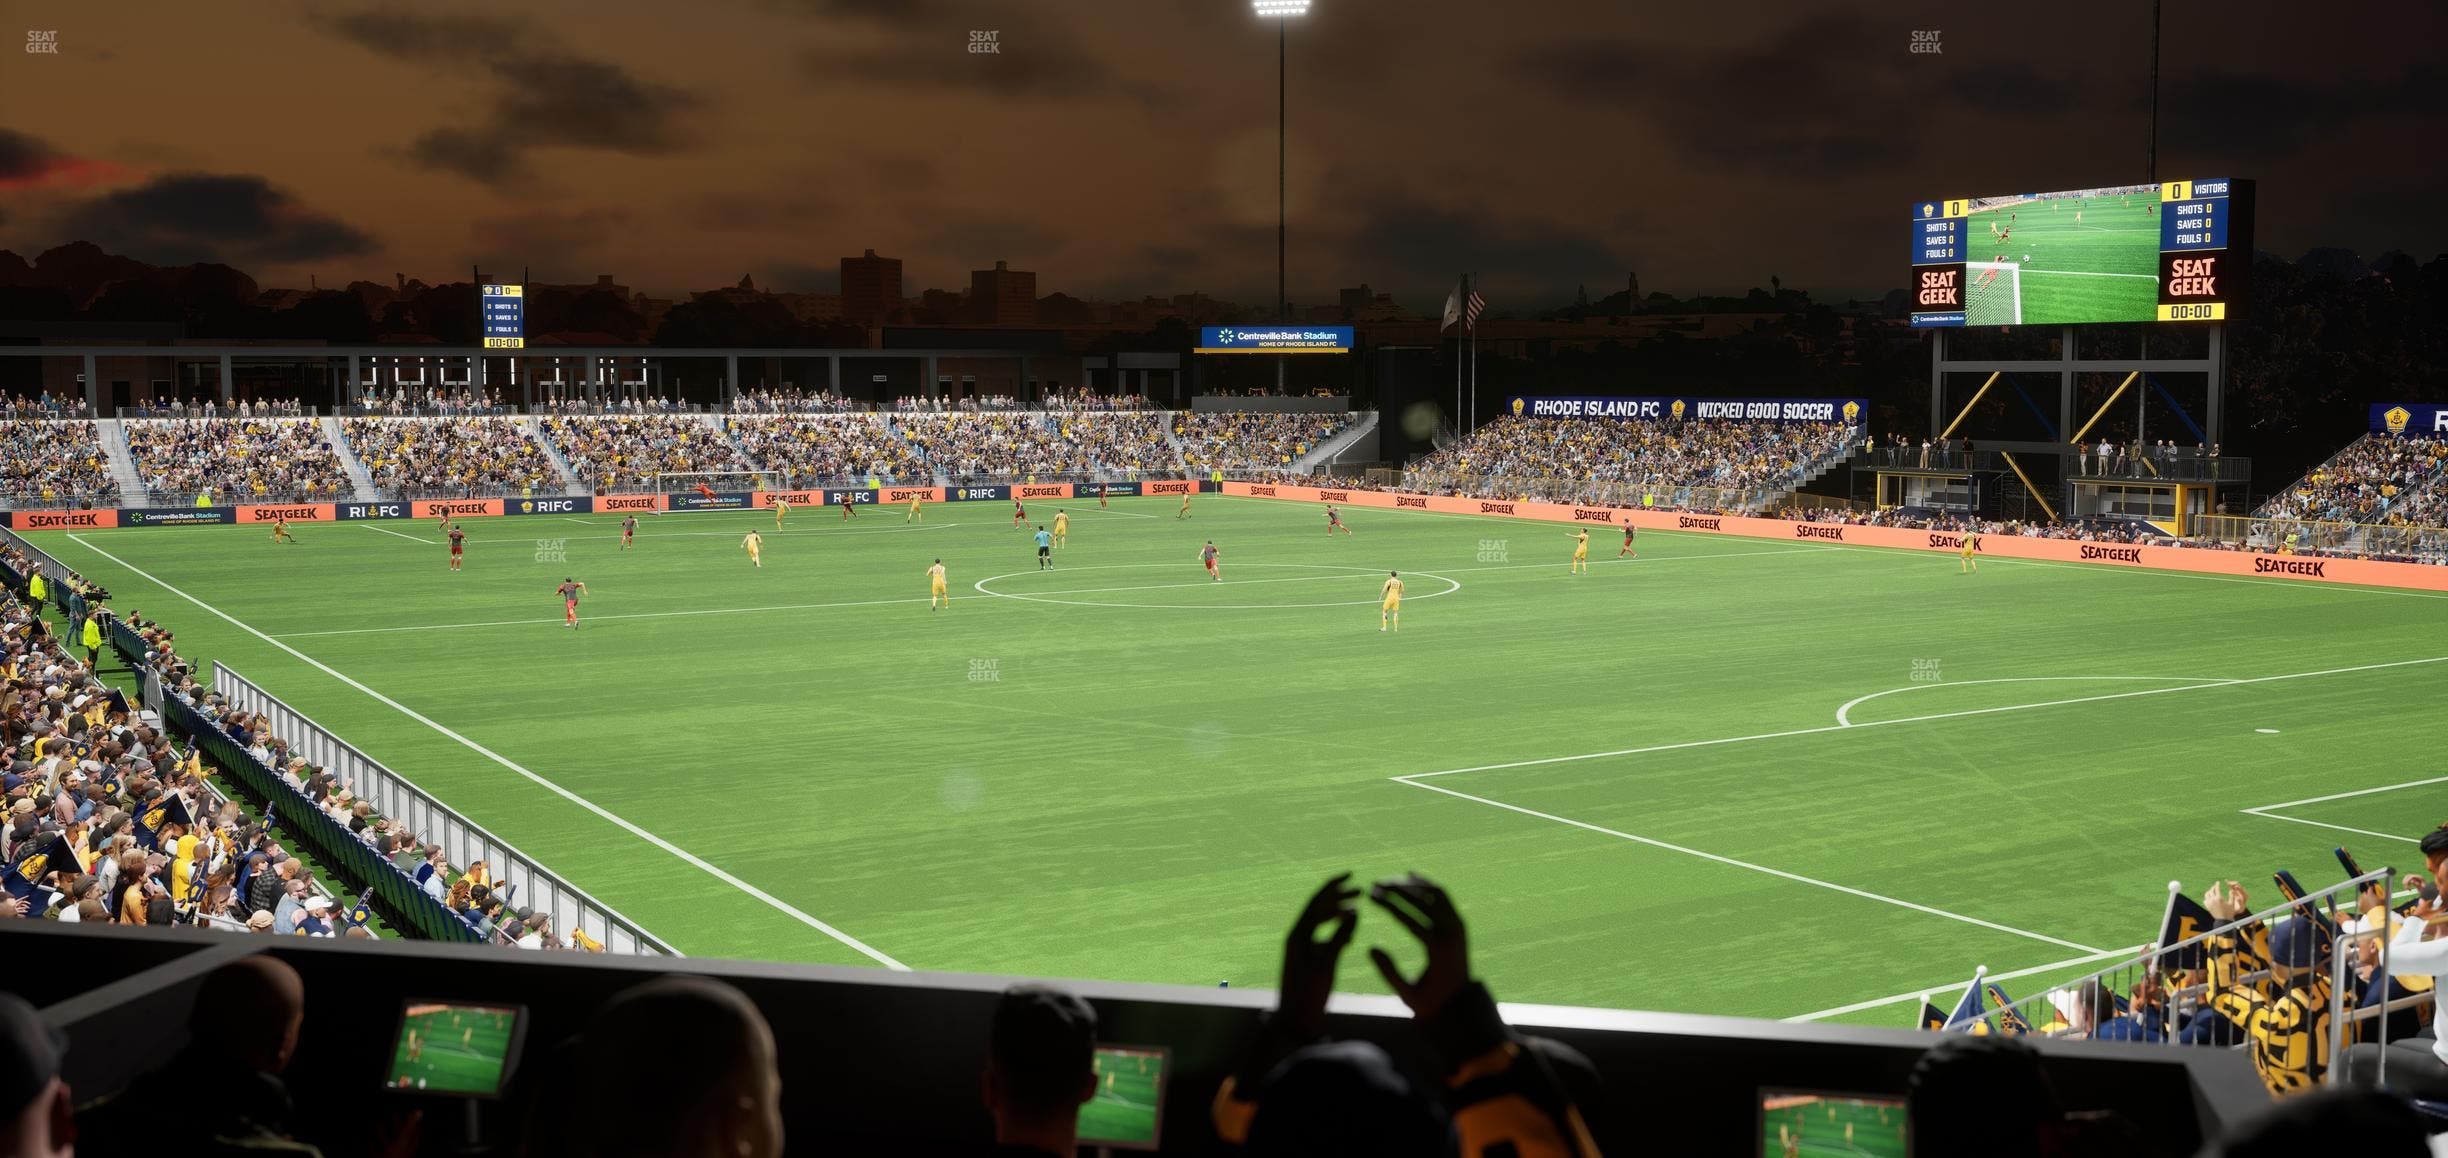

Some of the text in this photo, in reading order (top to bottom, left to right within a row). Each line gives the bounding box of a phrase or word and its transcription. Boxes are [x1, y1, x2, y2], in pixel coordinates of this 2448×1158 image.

[2195, 183, 2228, 194] VISITORS
[2177, 203, 2212, 215] SHOTS 0
[1926, 222, 1947, 232] SHOTS
[2177, 218, 2211, 229] SAVES 0
[1926, 236, 1947, 245] SAVES
[2176, 232, 2211, 244] FOULS 0
[1926, 249, 1946, 258] FOULS
[2172, 257, 2215, 278] SEAT
[1921, 270, 1957, 289] SEAT
[2169, 277, 2216, 296] GEEK
[1920, 288, 1957, 305] GEEK
[2171, 305, 2212, 319] 00:00
[1303, 332, 1337, 340] Stadium
[1534, 400, 1660, 417] RHODE ISLAND FC
[1697, 401, 1834, 420] WICKED GOOD SOCCER
[969, 488, 995, 499] RIFC
[1022, 486, 1062, 498] SEATGEEK
[1153, 483, 1190, 493] SEATGEEK
[1250, 485, 1276, 497] SEATGEEK
[855, 492, 869, 503] FC
[1320, 490, 1348, 503] SEATGEEK
[1396, 496, 1427, 509] SEATGEEK
[537, 501, 573, 513] RIFC
[606, 498, 655, 510] SEATGEEK
[1481, 502, 1514, 515] SEATGEEK
[255, 507, 317, 521] SEATGEEK
[350, 505, 399, 518] RI FC
[1574, 508, 1612, 523] SEATGEEK
[29, 513, 98, 528] SEATGEEK
[1679, 516, 1721, 532] SEATGEEK
[1796, 525, 1844, 541] SEATGEEK
[2080, 545, 2141, 564] SEATGEEK
[2254, 557, 2326, 578] SEATGEEK
